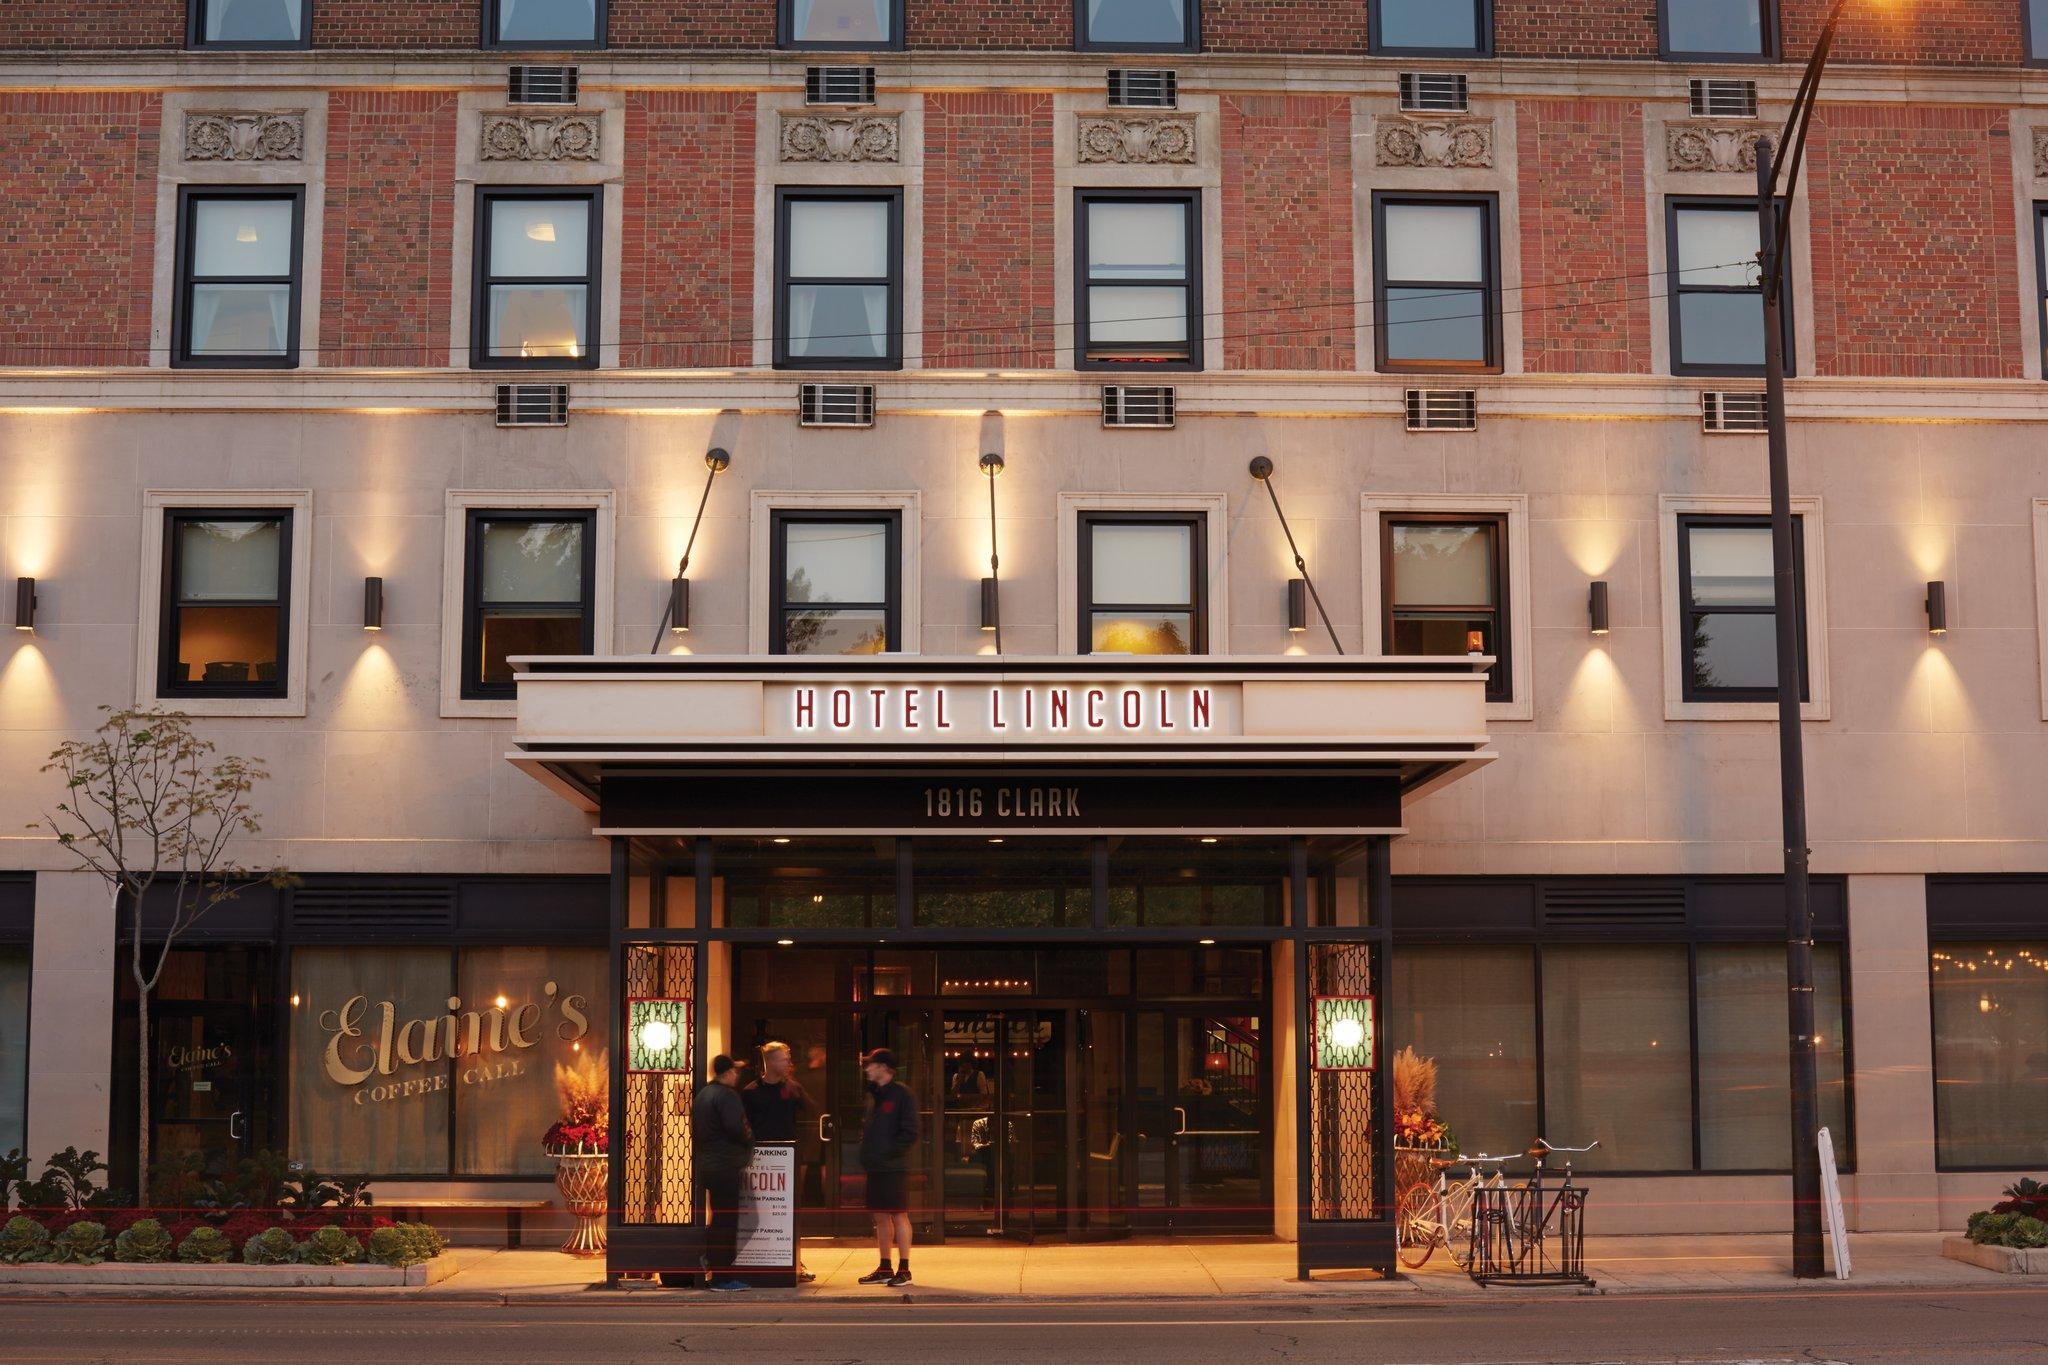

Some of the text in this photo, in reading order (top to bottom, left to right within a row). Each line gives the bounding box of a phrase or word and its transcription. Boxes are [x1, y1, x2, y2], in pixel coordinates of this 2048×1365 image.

[796, 689, 1210, 728] HOTEL LINCOLN
[924, 788, 1081, 817] 1816 CLARK
[319, 981, 588, 1085] Elaine's
[354, 1060, 525, 1105] COFFEE CALL
